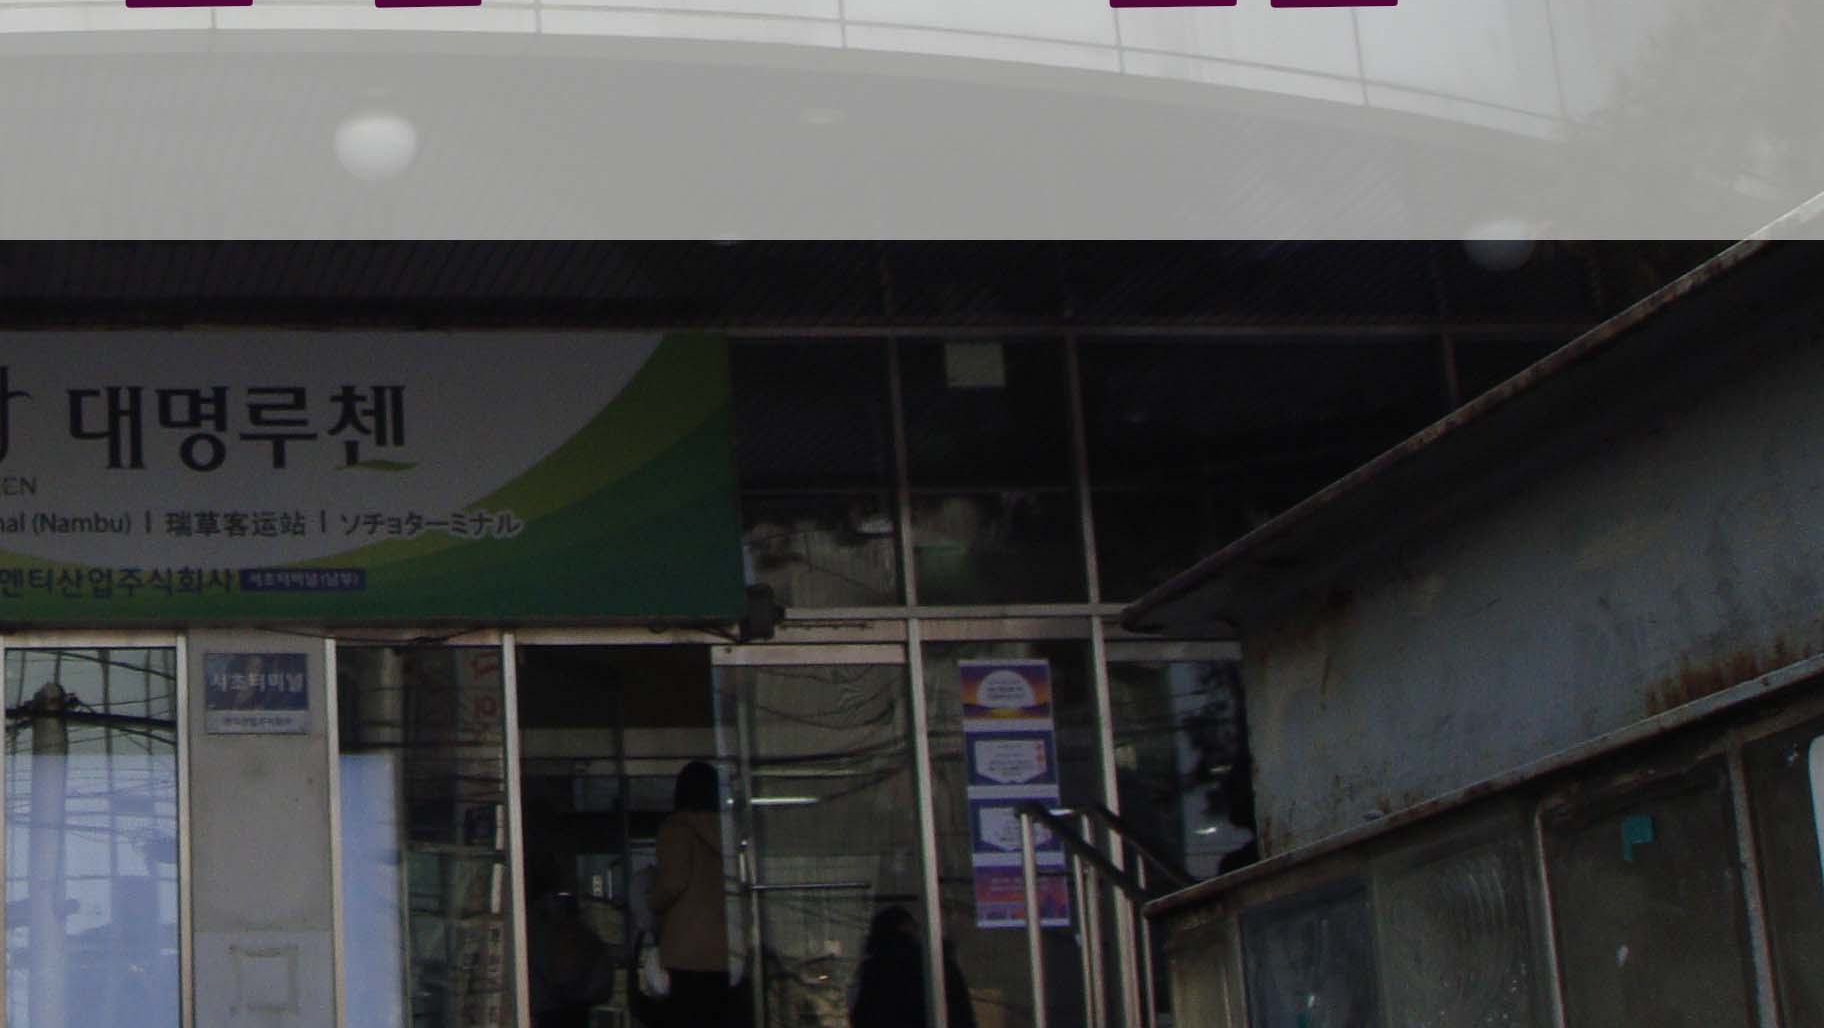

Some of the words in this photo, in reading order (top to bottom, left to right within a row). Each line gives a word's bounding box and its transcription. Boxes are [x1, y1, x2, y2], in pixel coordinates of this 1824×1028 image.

[67, 383, 419, 474] 대명루첸
[31, 511, 133, 536] (Nambu)
[164, 510, 307, 538] 瑞草客运站
[339, 512, 521, 538] ソチョターミナル
